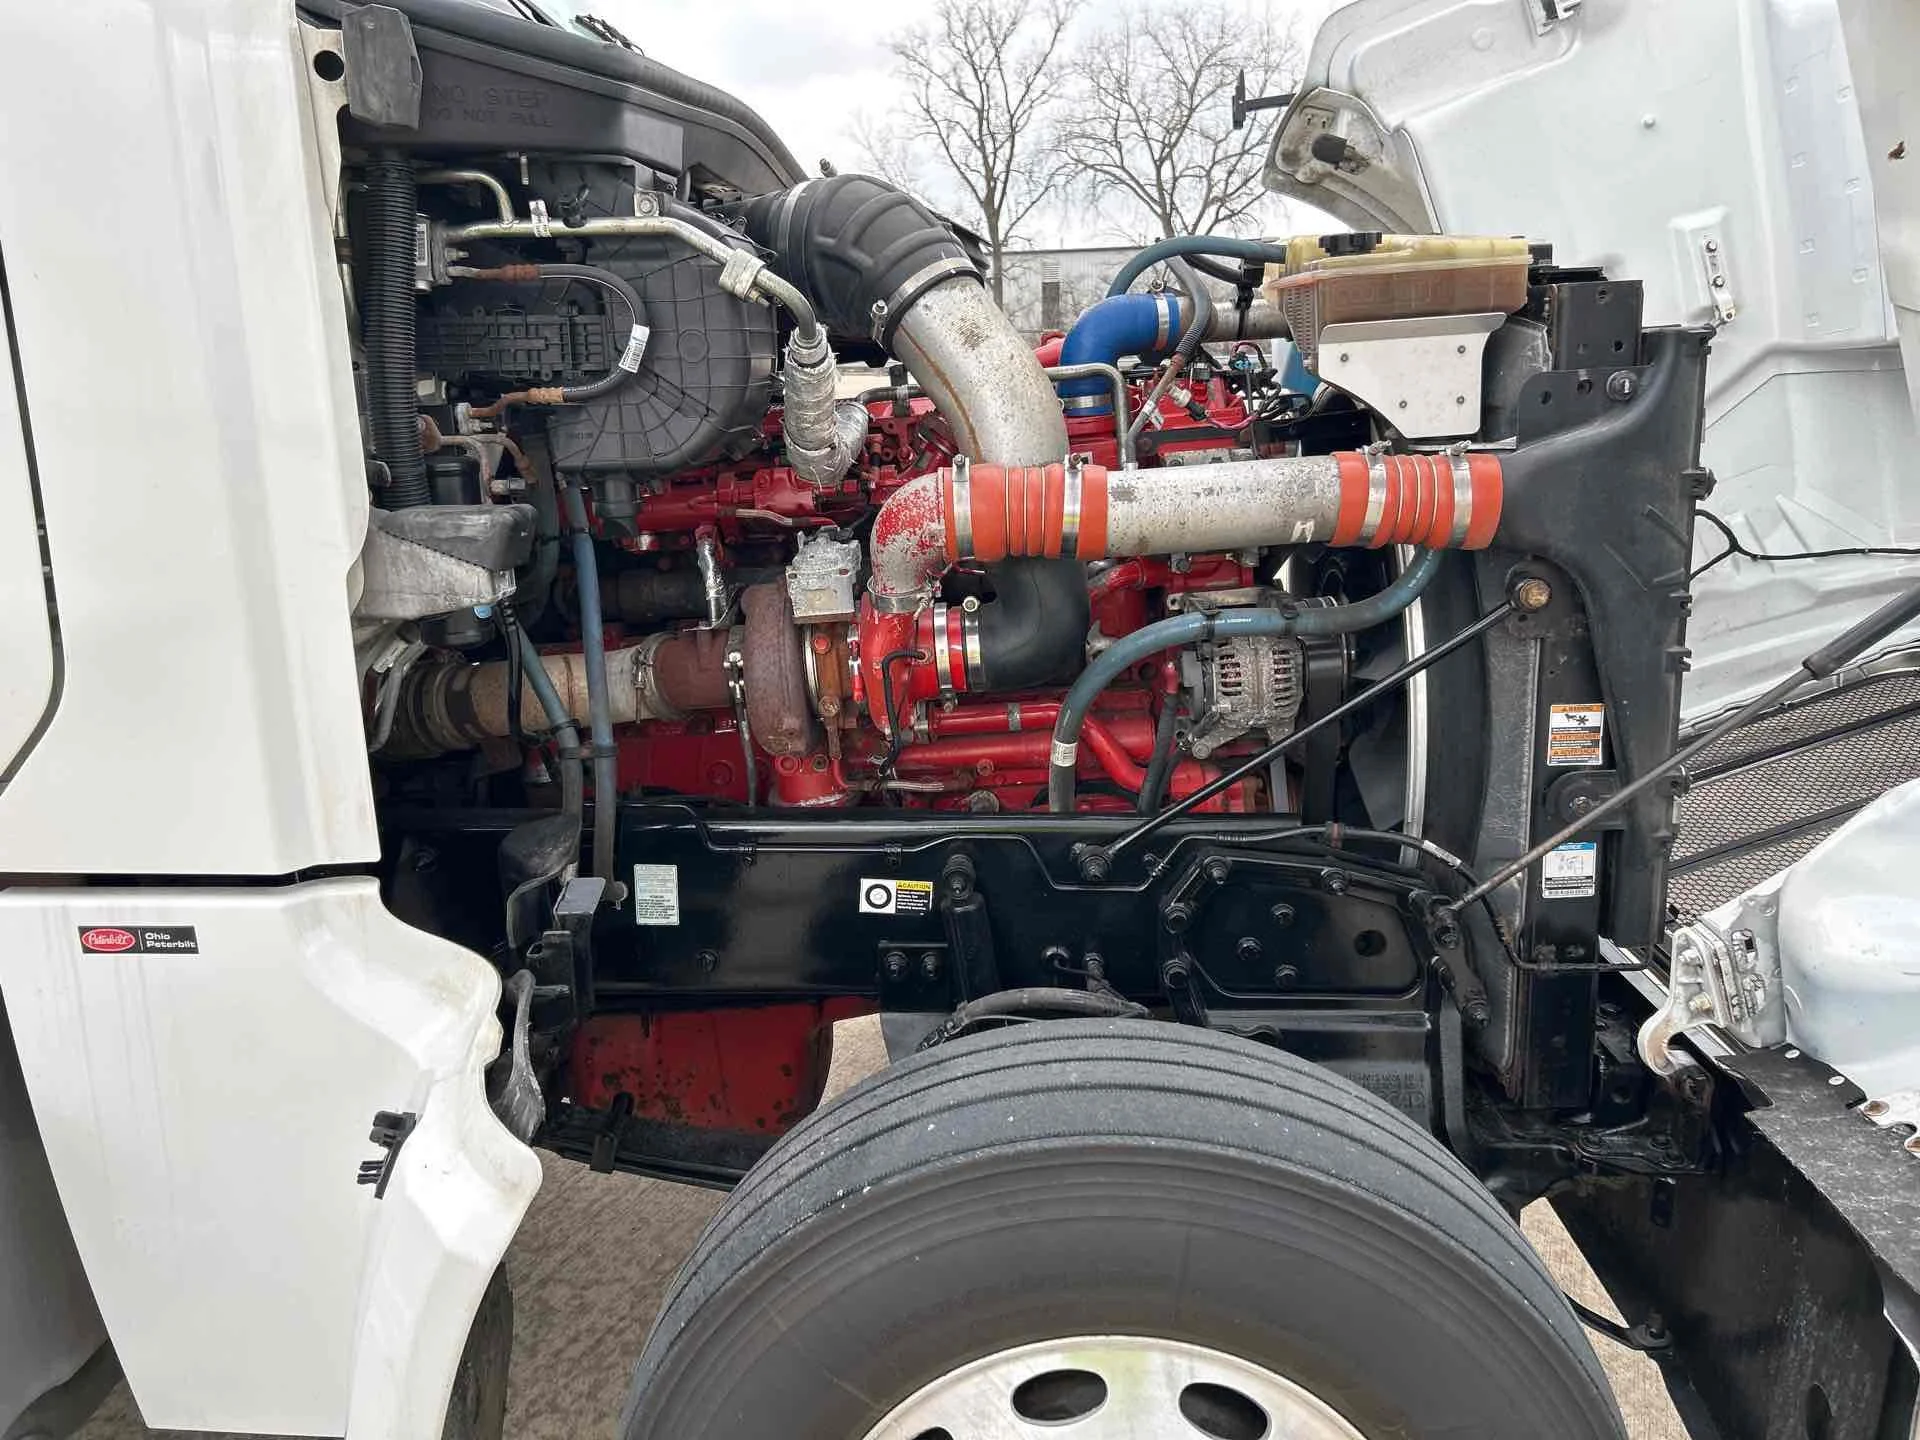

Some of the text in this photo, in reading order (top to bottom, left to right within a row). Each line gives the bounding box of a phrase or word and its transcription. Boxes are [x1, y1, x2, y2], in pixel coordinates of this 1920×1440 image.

[431, 82, 551, 108] NO STEP
[463, 109, 497, 123] NOT
[145, 932, 171, 940] Ohio
[146, 940, 196, 948] Peterbilt
